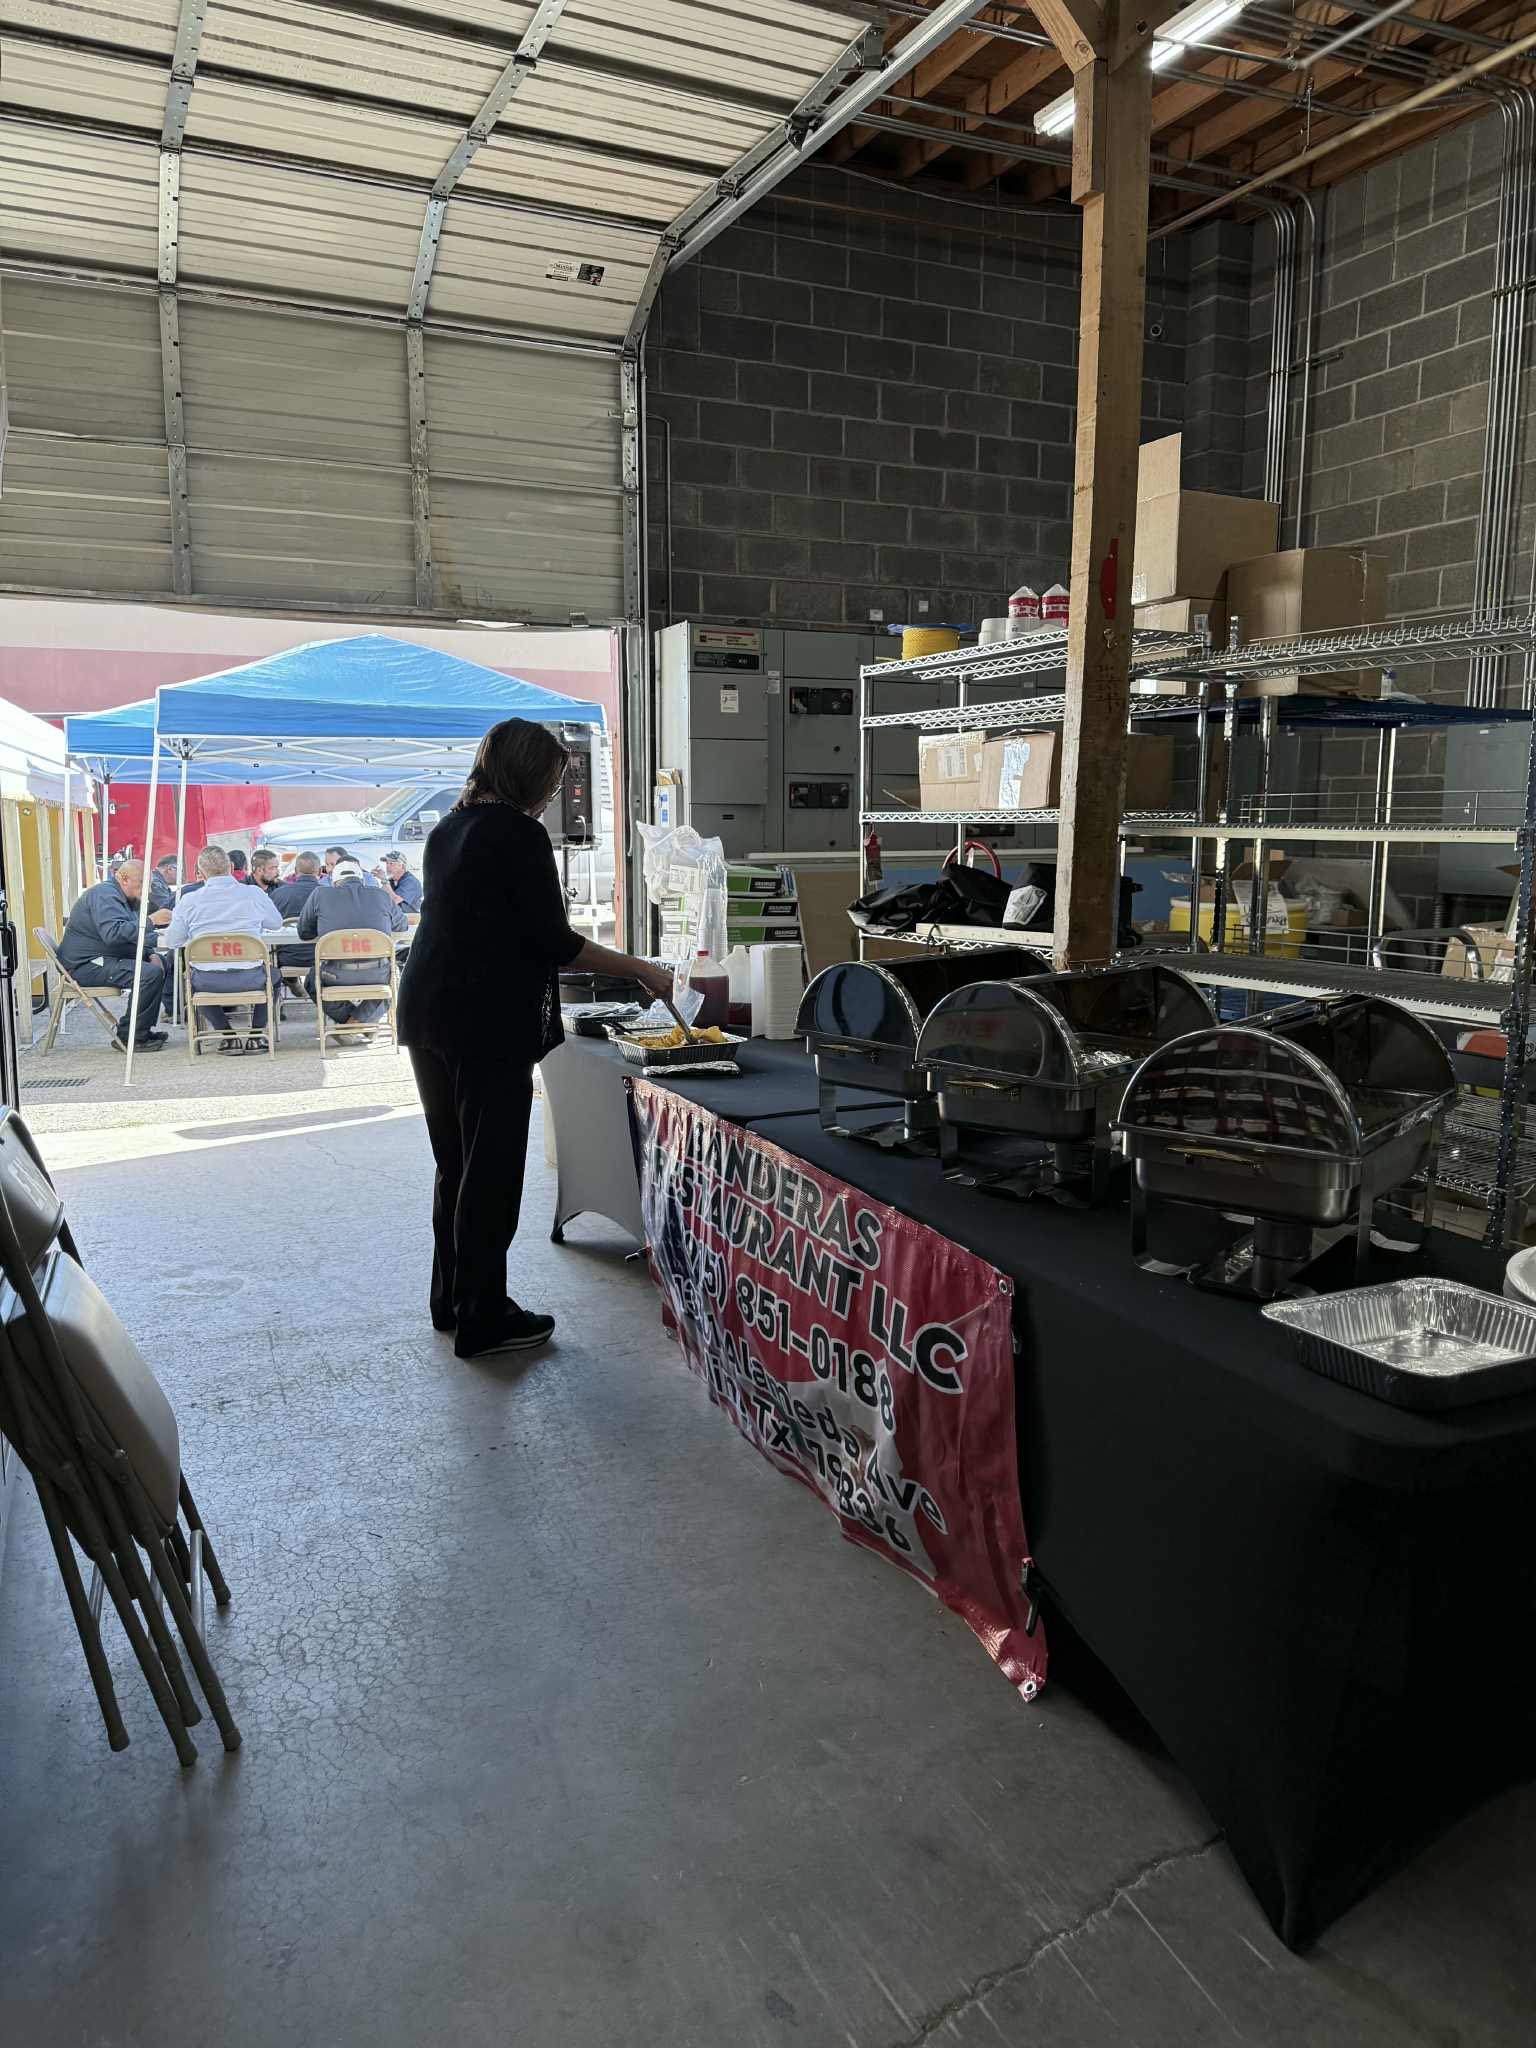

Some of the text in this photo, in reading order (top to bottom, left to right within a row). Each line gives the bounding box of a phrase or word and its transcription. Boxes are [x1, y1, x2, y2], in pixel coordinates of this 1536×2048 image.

[736, 1273, 896, 1436] 851-0188
[869, 1285, 970, 1394] LLC
[722, 1329, 860, 1467] Alameda
[865, 1447, 948, 1534] Ave
